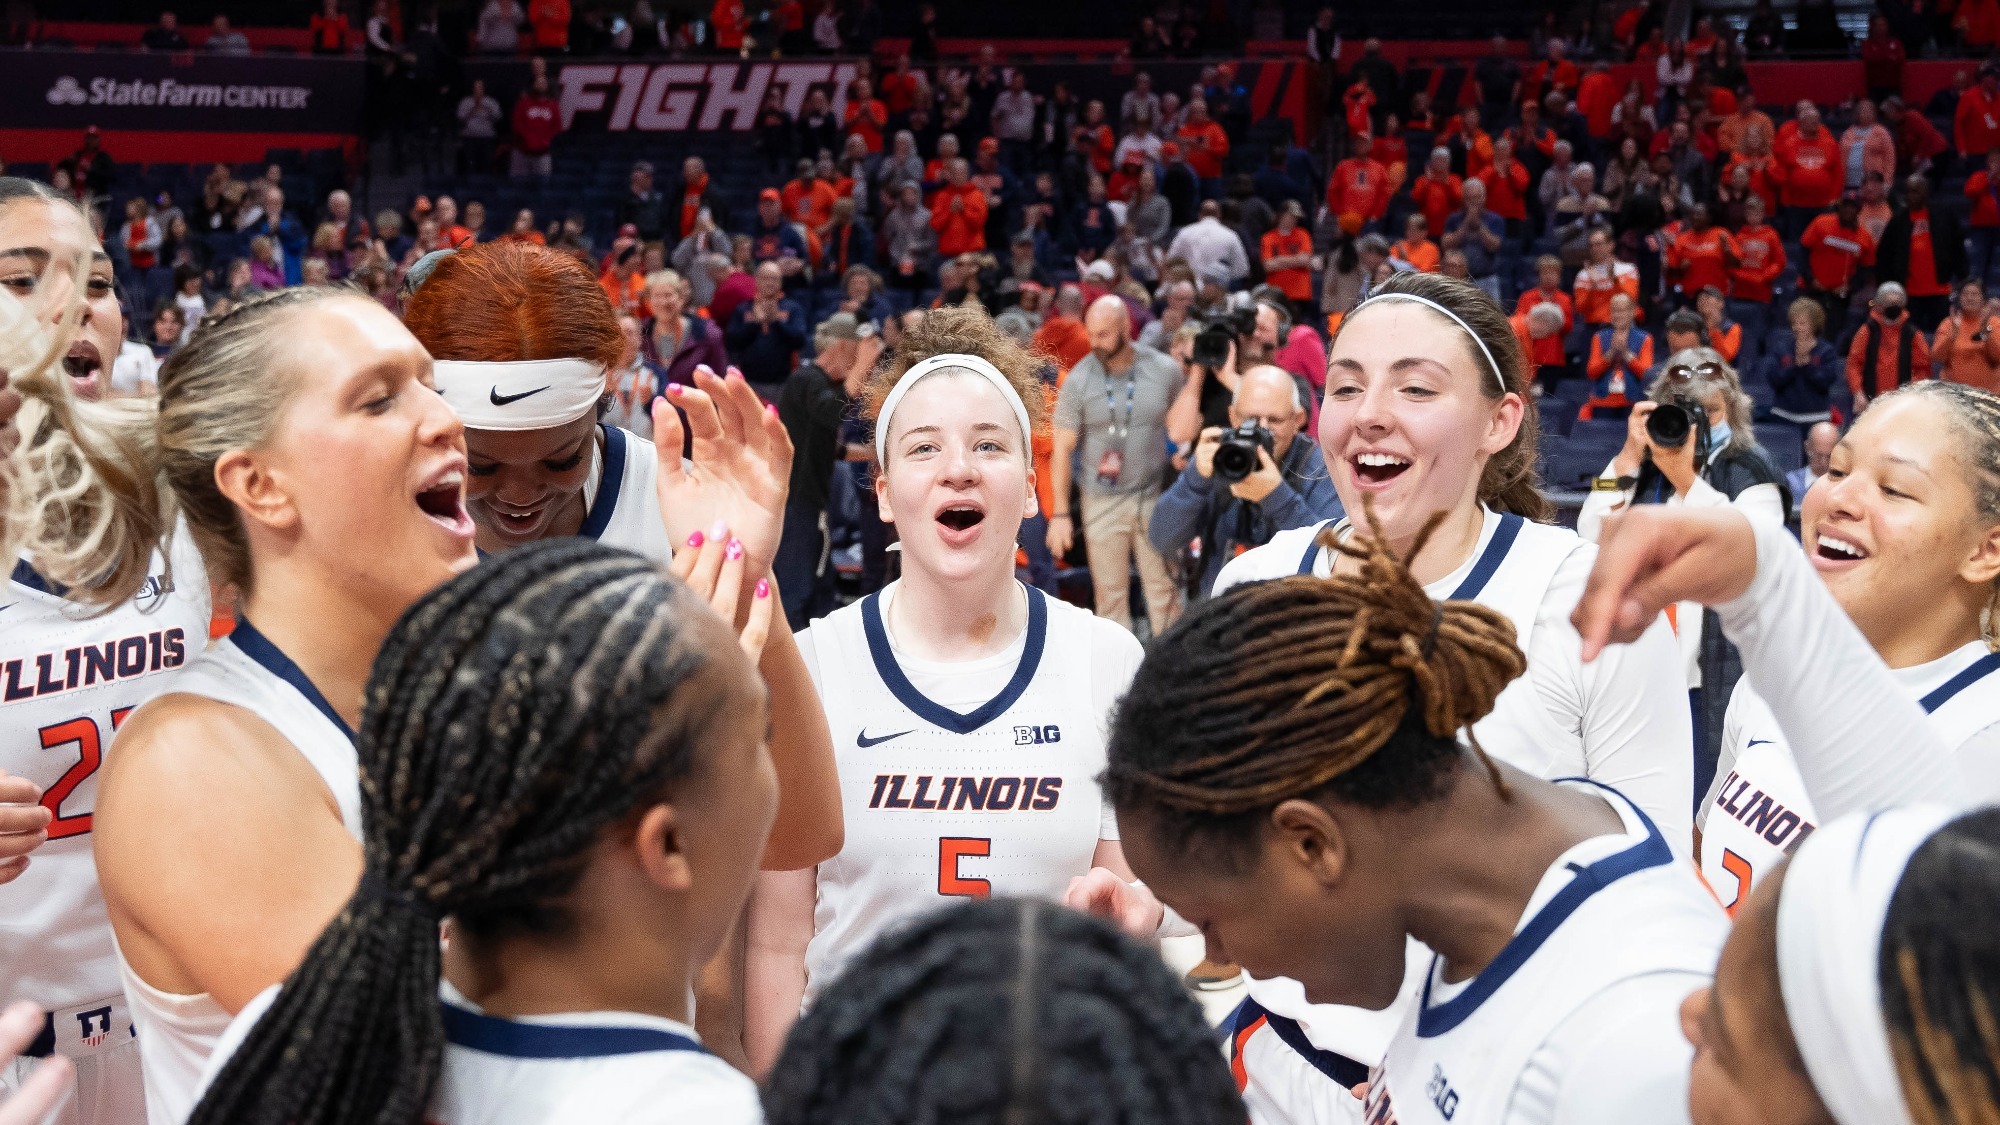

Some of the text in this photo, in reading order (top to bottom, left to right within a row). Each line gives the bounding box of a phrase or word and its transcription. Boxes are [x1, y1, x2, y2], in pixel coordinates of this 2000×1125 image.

[223, 85, 311, 109] CENTER
[0, 627, 185, 702] LLINOIS
[38, 704, 138, 840] 2
[868, 774, 1063, 811] ILLINOIS
[938, 836, 992, 902] 5
